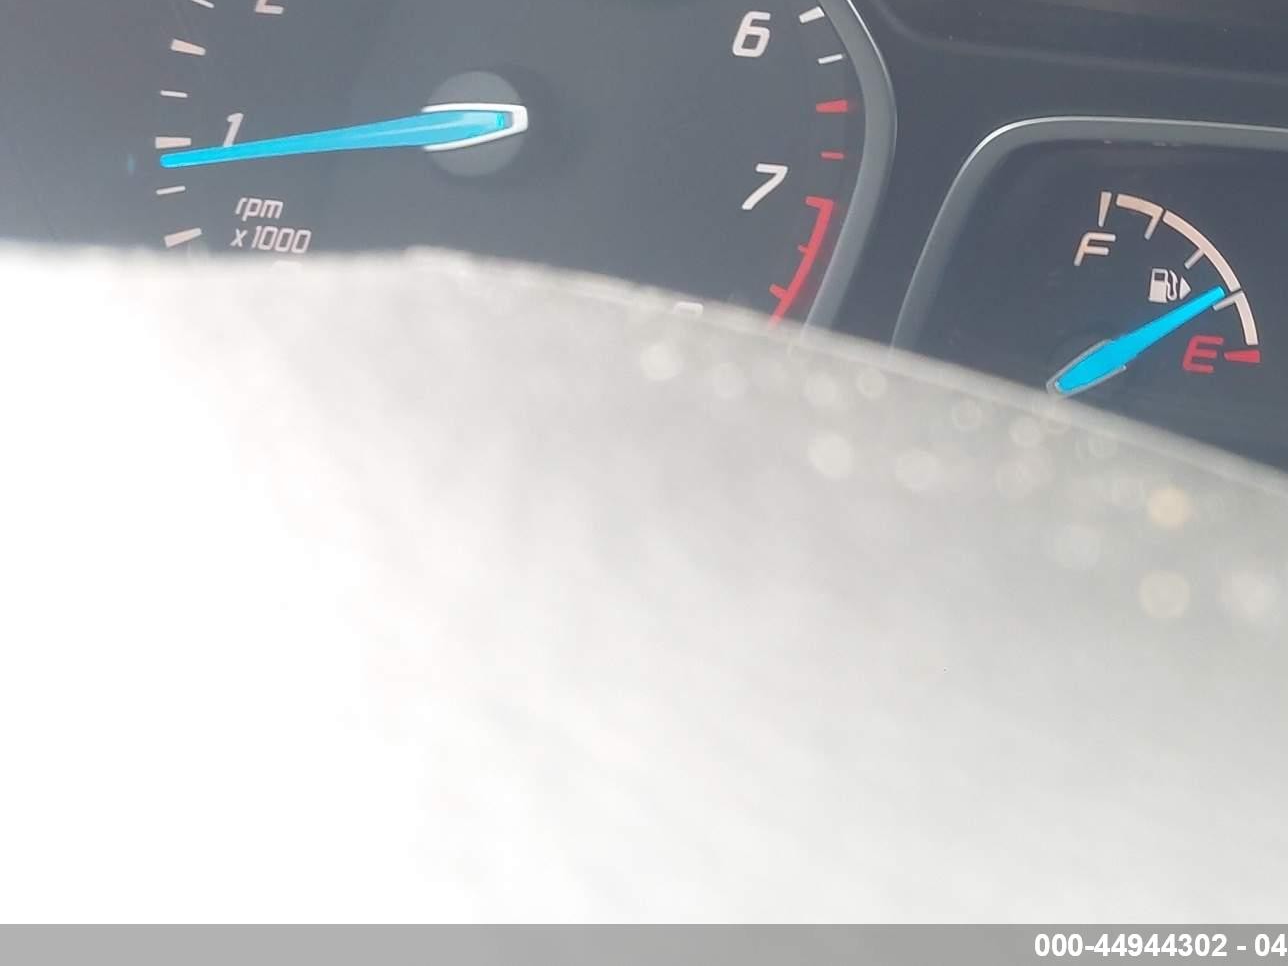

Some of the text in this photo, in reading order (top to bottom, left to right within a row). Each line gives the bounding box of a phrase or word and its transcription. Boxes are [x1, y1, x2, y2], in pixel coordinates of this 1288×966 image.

[731, 12, 771, 58] 6
[221, 113, 244, 149] 1
[741, 163, 788, 211] 7
[235, 195, 284, 221] rpm
[252, 225, 311, 255] 1000
[1073, 232, 1116, 266] F
[1182, 335, 1224, 373] E
